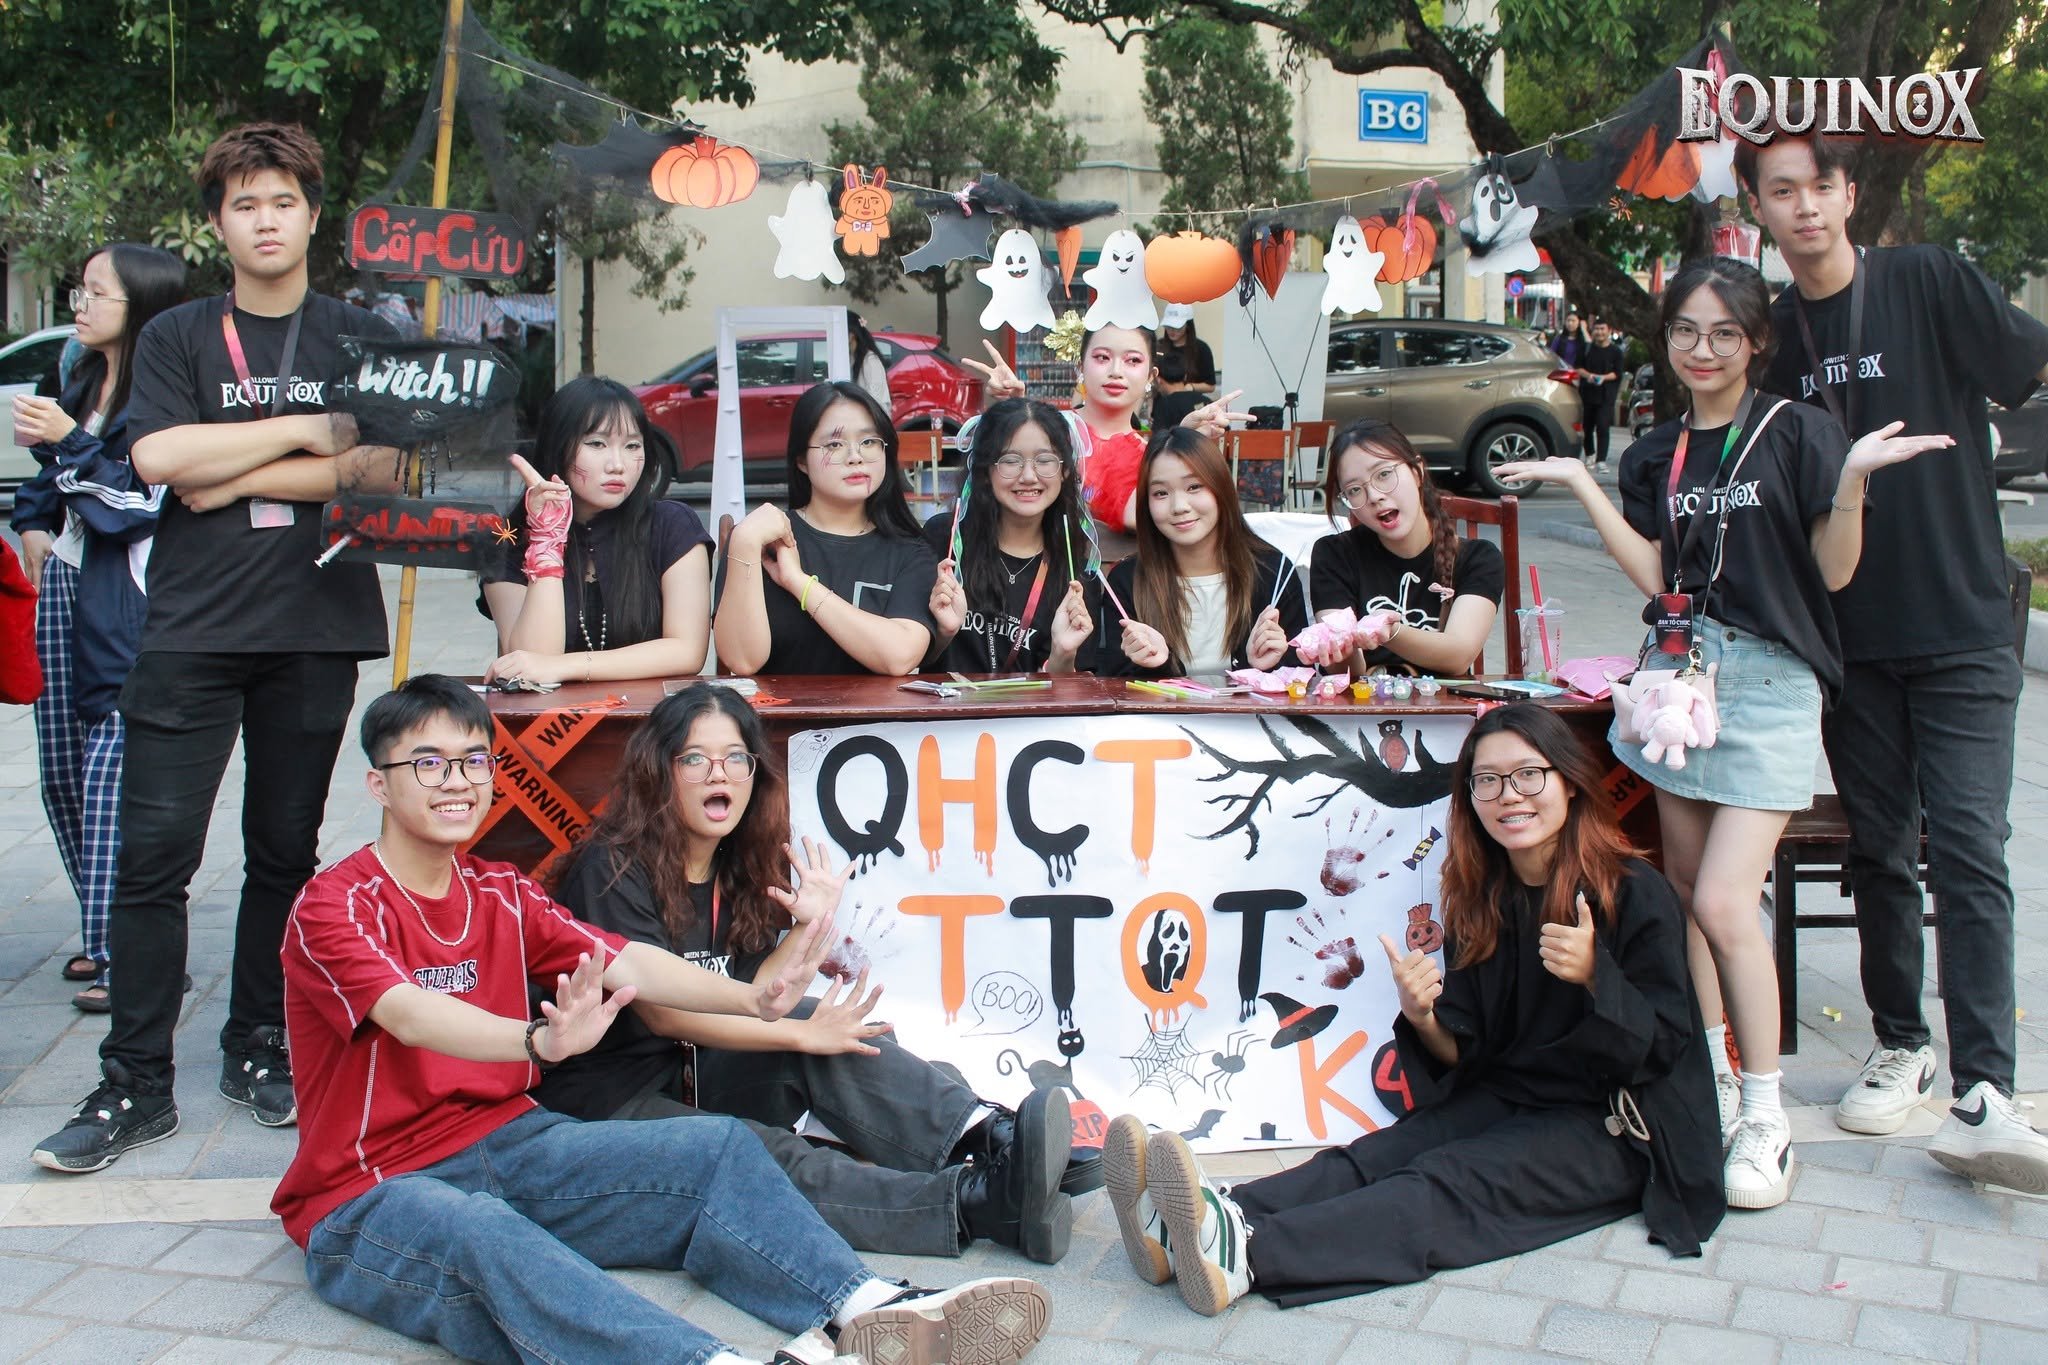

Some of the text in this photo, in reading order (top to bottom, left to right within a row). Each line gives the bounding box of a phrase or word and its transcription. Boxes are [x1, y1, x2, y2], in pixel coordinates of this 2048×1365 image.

[1367, 99, 1422, 131] B6
[817, 733, 1193, 887] QHCT
[897, 889, 1308, 1032] TTQT
[982, 981, 1040, 1021] BOO!
